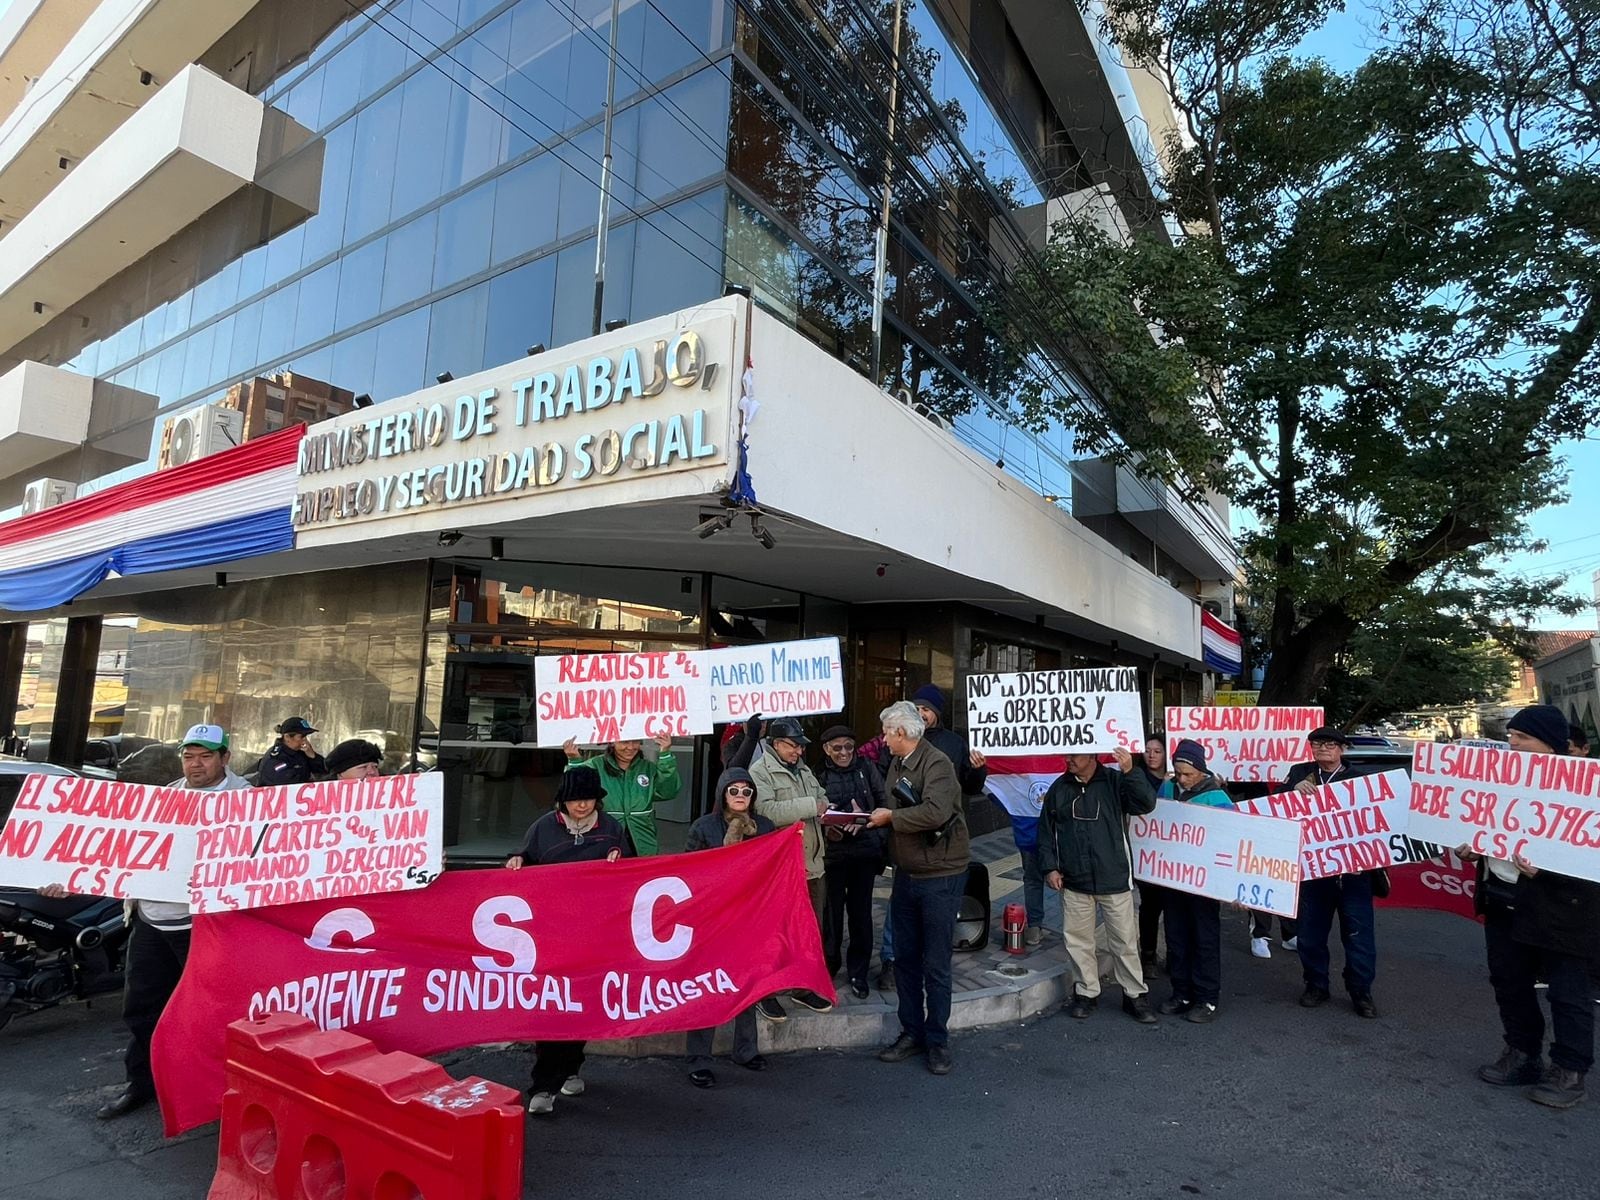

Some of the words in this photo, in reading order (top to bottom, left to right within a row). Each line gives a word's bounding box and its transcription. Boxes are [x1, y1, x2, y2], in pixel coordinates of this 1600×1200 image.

[296, 403, 447, 475] MINISTERIO
[452, 387, 498, 441] DE
[511, 329, 719, 427] TRABAJO,
[290, 478, 375, 525] EMPLEO
[377, 475, 397, 511] Y
[395, 441, 567, 510] SEGURIDAD
[572, 409, 717, 480] SOCIAL
[557, 652, 670, 683] REAJUSTE
[674, 652, 700, 678] DEL
[710, 662, 764, 686] ALARIO
[968, 675, 991, 698] NO
[991, 674, 1000, 683] A
[1001, 685, 1015, 697] LA
[1016, 669, 1140, 696] DISCRIMINACION
[538, 687, 617, 721] SALARIO
[727, 689, 832, 715] EXPLOTACION
[969, 701, 977, 711] A
[978, 712, 998, 724] LAS
[1004, 696, 1086, 723] OBRERAS
[1096, 696, 1105, 720] Y
[1167, 707, 1185, 732] EL
[1189, 707, 1260, 732] SALARIO
[970, 724, 1097, 747] TRABAJADORAS.
[1239, 737, 1315, 762] ALCANZA
[1413, 742, 1435, 774] EL
[1440, 745, 1521, 786] SALARIO
[1525, 754, 1600, 799] MINIM
[15, 774, 48, 810] EL
[47, 776, 146, 821] SALARIO
[141, 786, 200, 826] MINI
[200, 786, 289, 827] CONTRA
[1267, 784, 1342, 820] MAFIA
[1342, 780, 1356, 806] Y
[1363, 772, 1395, 802] LA
[1409, 782, 1455, 819] DEBE
[1459, 789, 1498, 829] SER
[0, 818, 43, 859] NO
[345, 815, 380, 844] QUE
[383, 809, 429, 840] VAN
[1134, 814, 1206, 847] SALARIO
[1301, 805, 1391, 845] POLÍTICA
[191, 853, 310, 888] ELIMINANDO
[325, 841, 428, 875] DERECHOS
[1236, 839, 1299, 884] HAMBRE
[1315, 838, 1392, 877] ESTADO
[191, 890, 208, 914] DE
[217, 888, 239, 911] LOS
[244, 870, 404, 908] TRABAJADORES
[423, 968, 583, 1013] SINDICAL
[601, 968, 741, 1021] CLASISTA
